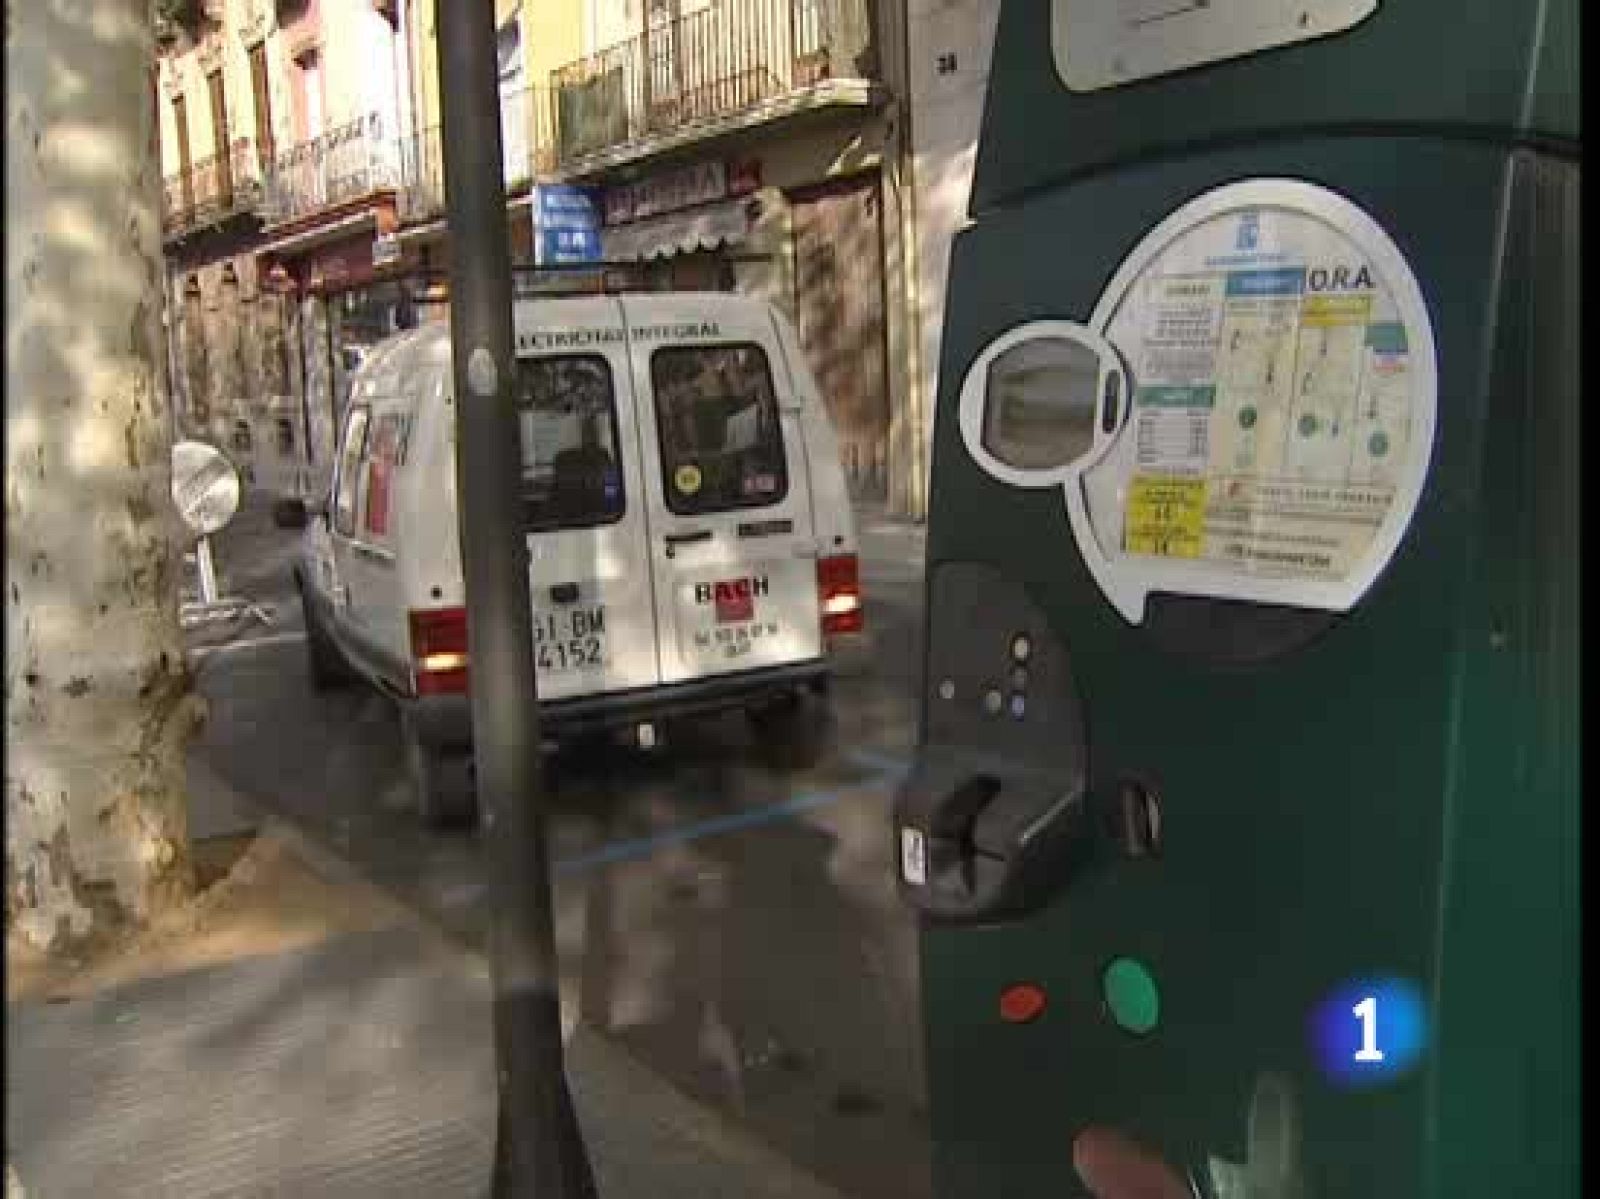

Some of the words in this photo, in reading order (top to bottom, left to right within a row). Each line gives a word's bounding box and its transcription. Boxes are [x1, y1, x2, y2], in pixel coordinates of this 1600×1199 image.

[630, 321, 721, 343] INTEGRAL
[694, 575, 769, 605] BACH
[538, 637, 602, 669] 4152
